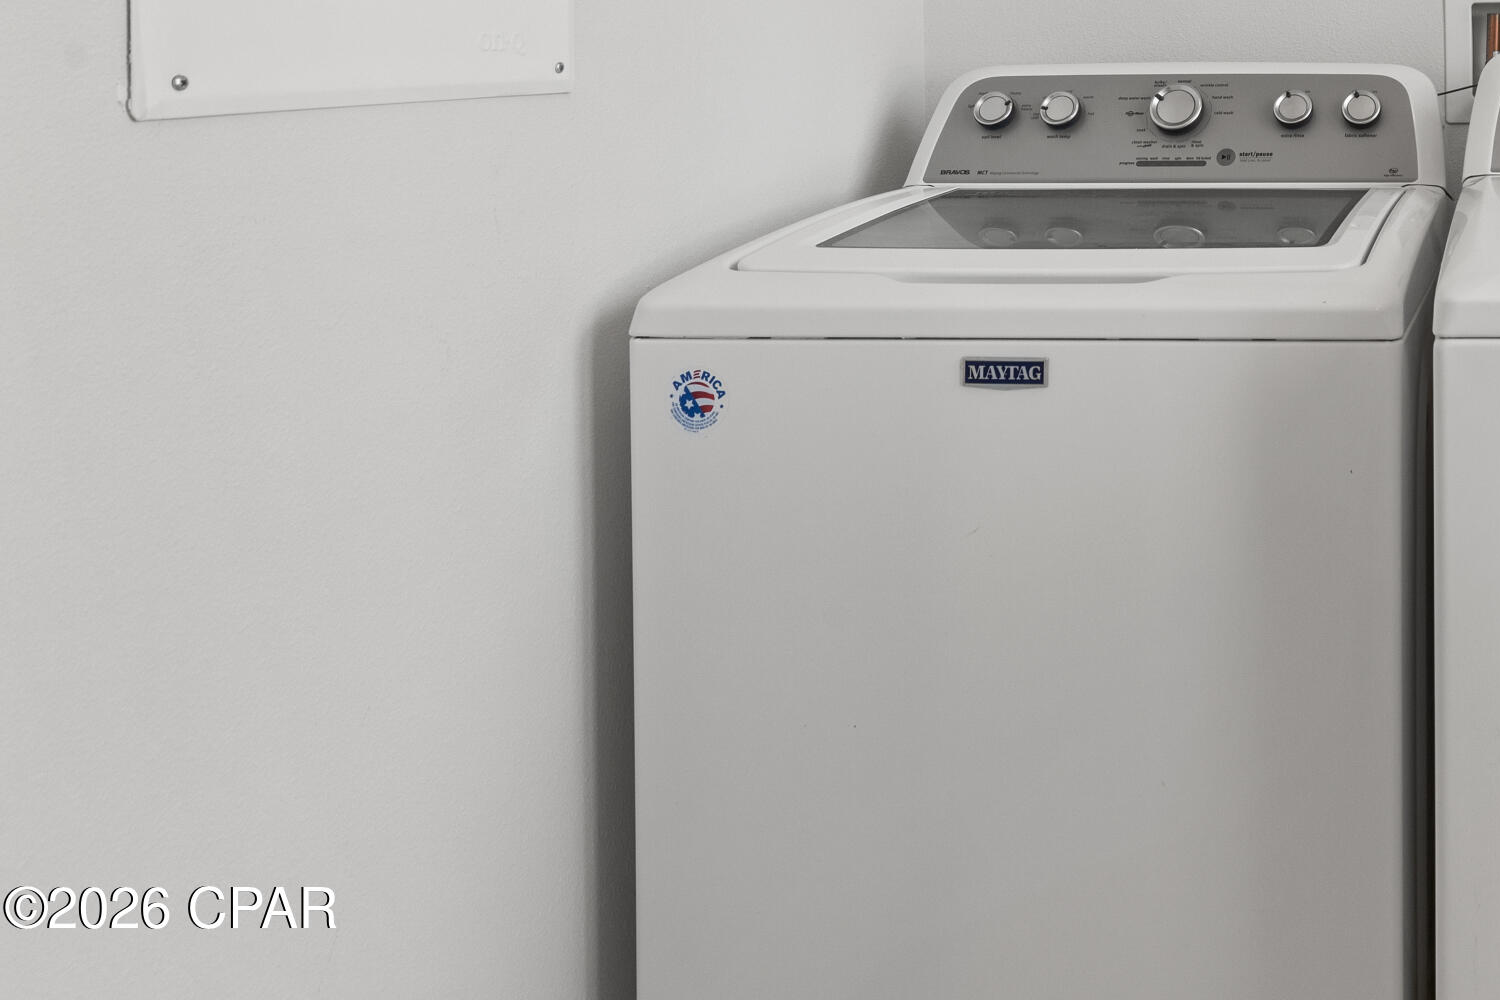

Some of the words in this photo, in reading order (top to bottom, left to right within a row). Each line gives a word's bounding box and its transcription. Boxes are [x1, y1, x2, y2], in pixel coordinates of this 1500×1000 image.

[1239, 151, 1273, 159] start/pause
[967, 365, 1042, 380] MAYTAG
[672, 369, 727, 401] AMERICA
